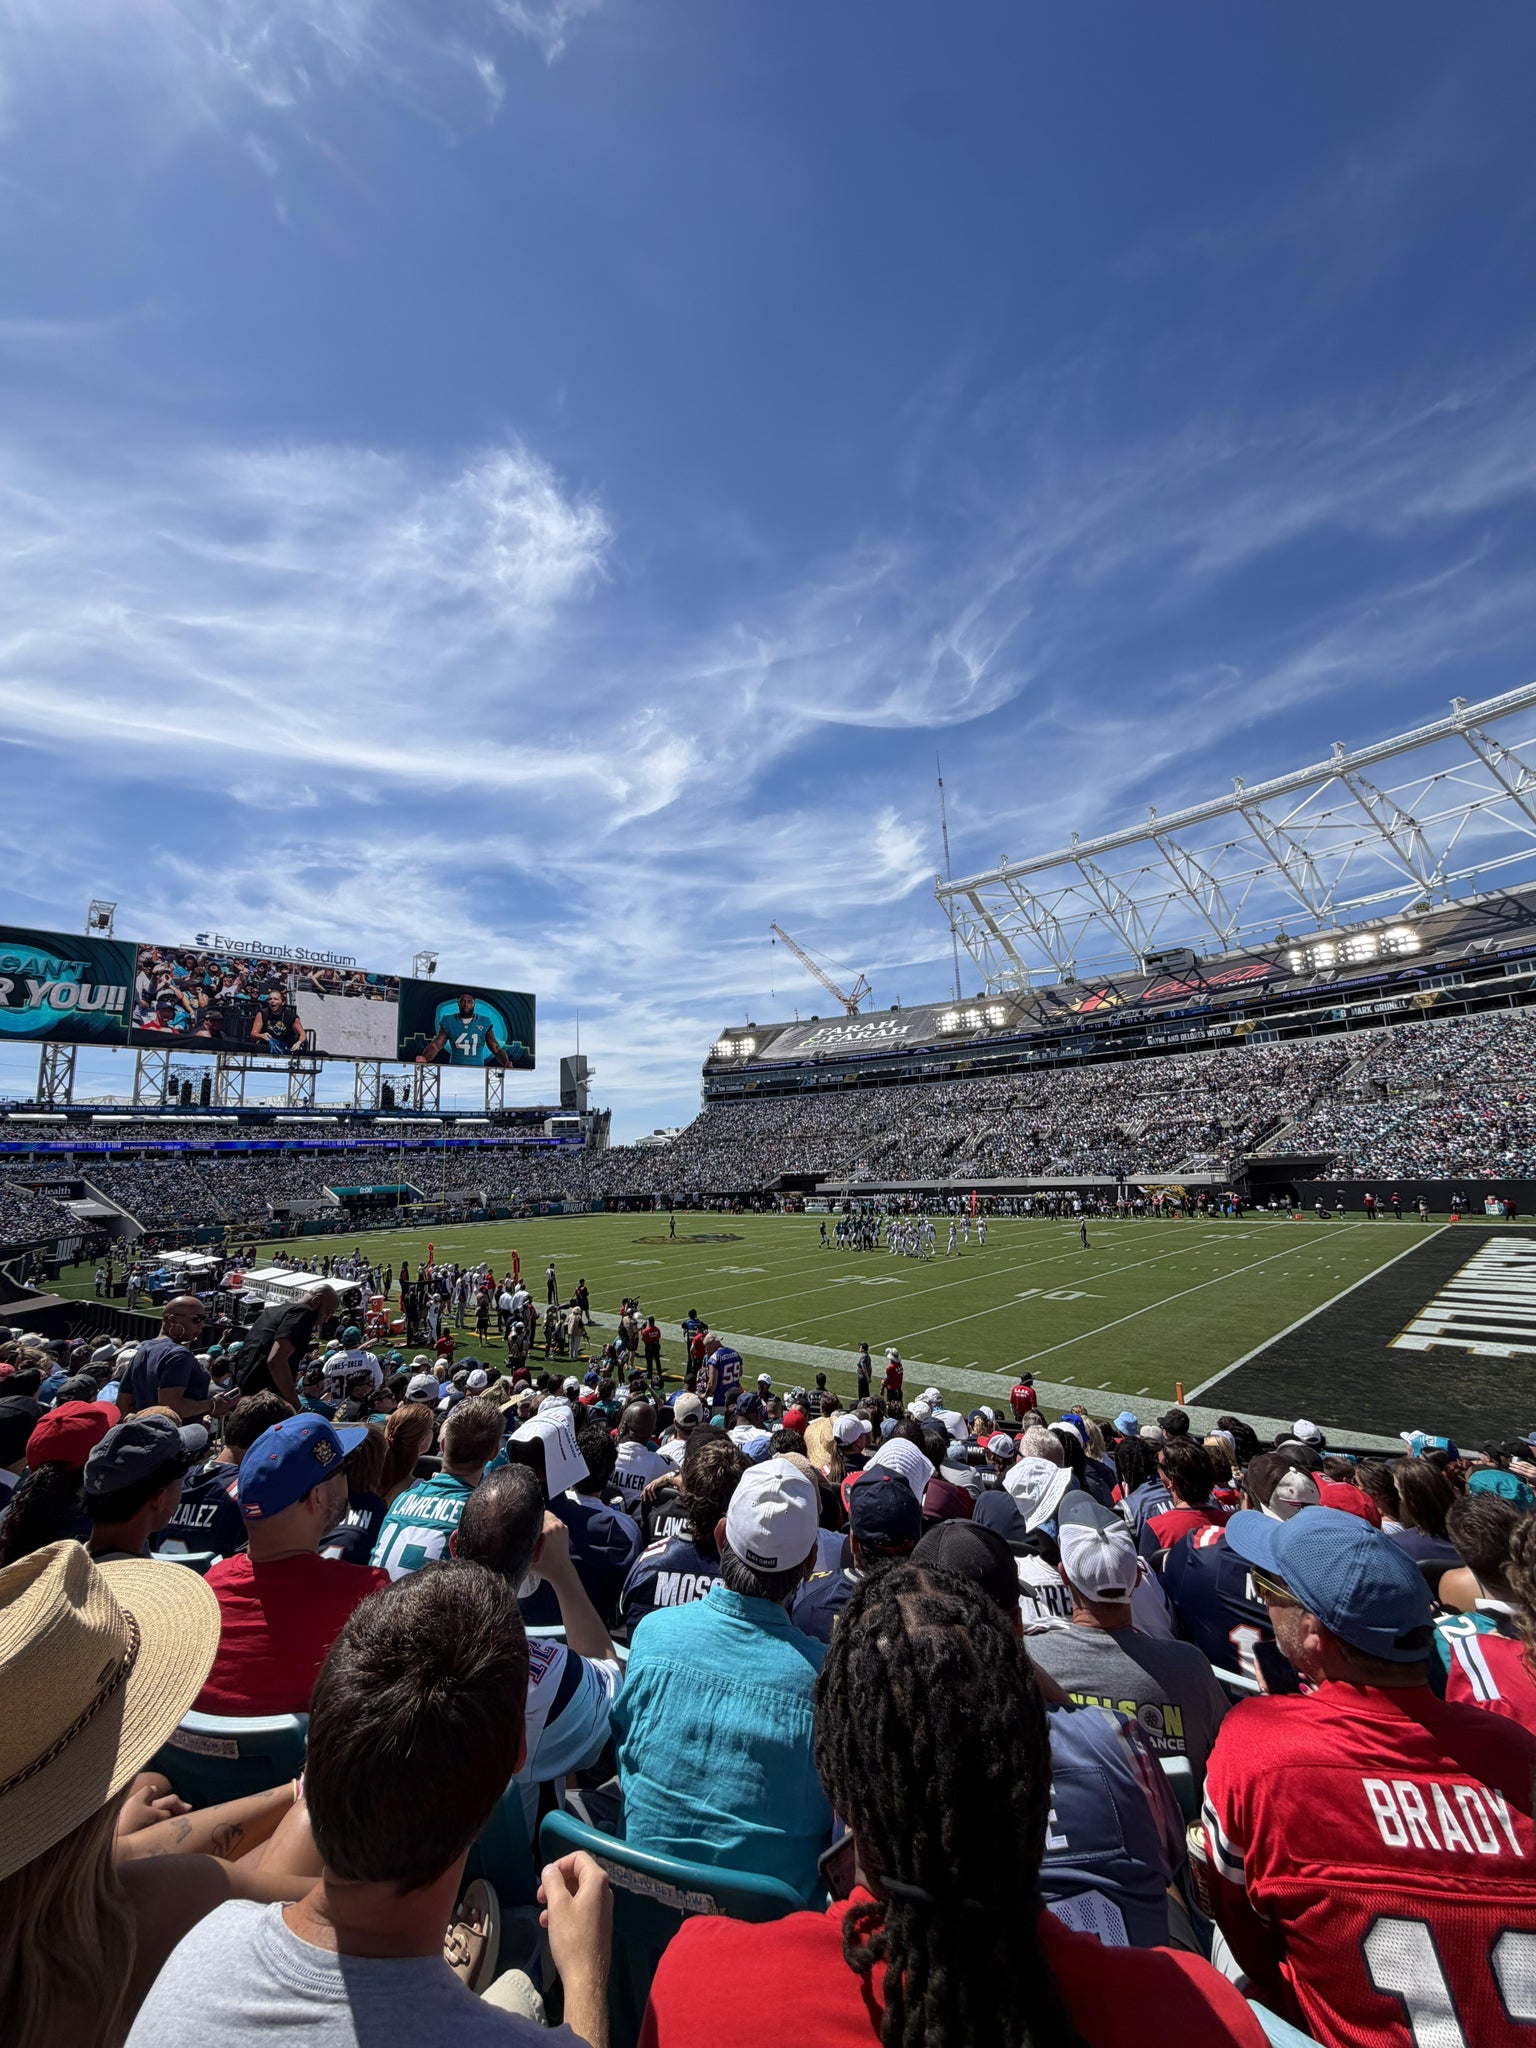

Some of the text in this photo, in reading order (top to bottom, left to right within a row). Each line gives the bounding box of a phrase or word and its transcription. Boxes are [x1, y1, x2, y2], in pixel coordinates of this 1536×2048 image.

[214, 935, 357, 966] EverBank Stadium
[0, 954, 92, 979] CAN'T
[1142, 961, 1272, 1000] Coca-Cola
[25, 979, 128, 1011] YOU!!
[1351, 1005, 1373, 1017] MARK
[817, 1020, 899, 1036] FARAH
[826, 1025, 912, 1044] FARAH
[1167, 1034, 1180, 1043] AND
[1206, 1027, 1232, 1038] WEAVER
[455, 1033, 479, 1056] 41
[39, 1186, 71, 1196] Health
[828, 1275, 898, 1285] 20
[1014, 1288, 1088, 1300] 10
[722, 1361, 741, 1385] 59
[392, 1494, 465, 1524] LAWRENCE
[1362, 1781, 1524, 1857] BRADY
